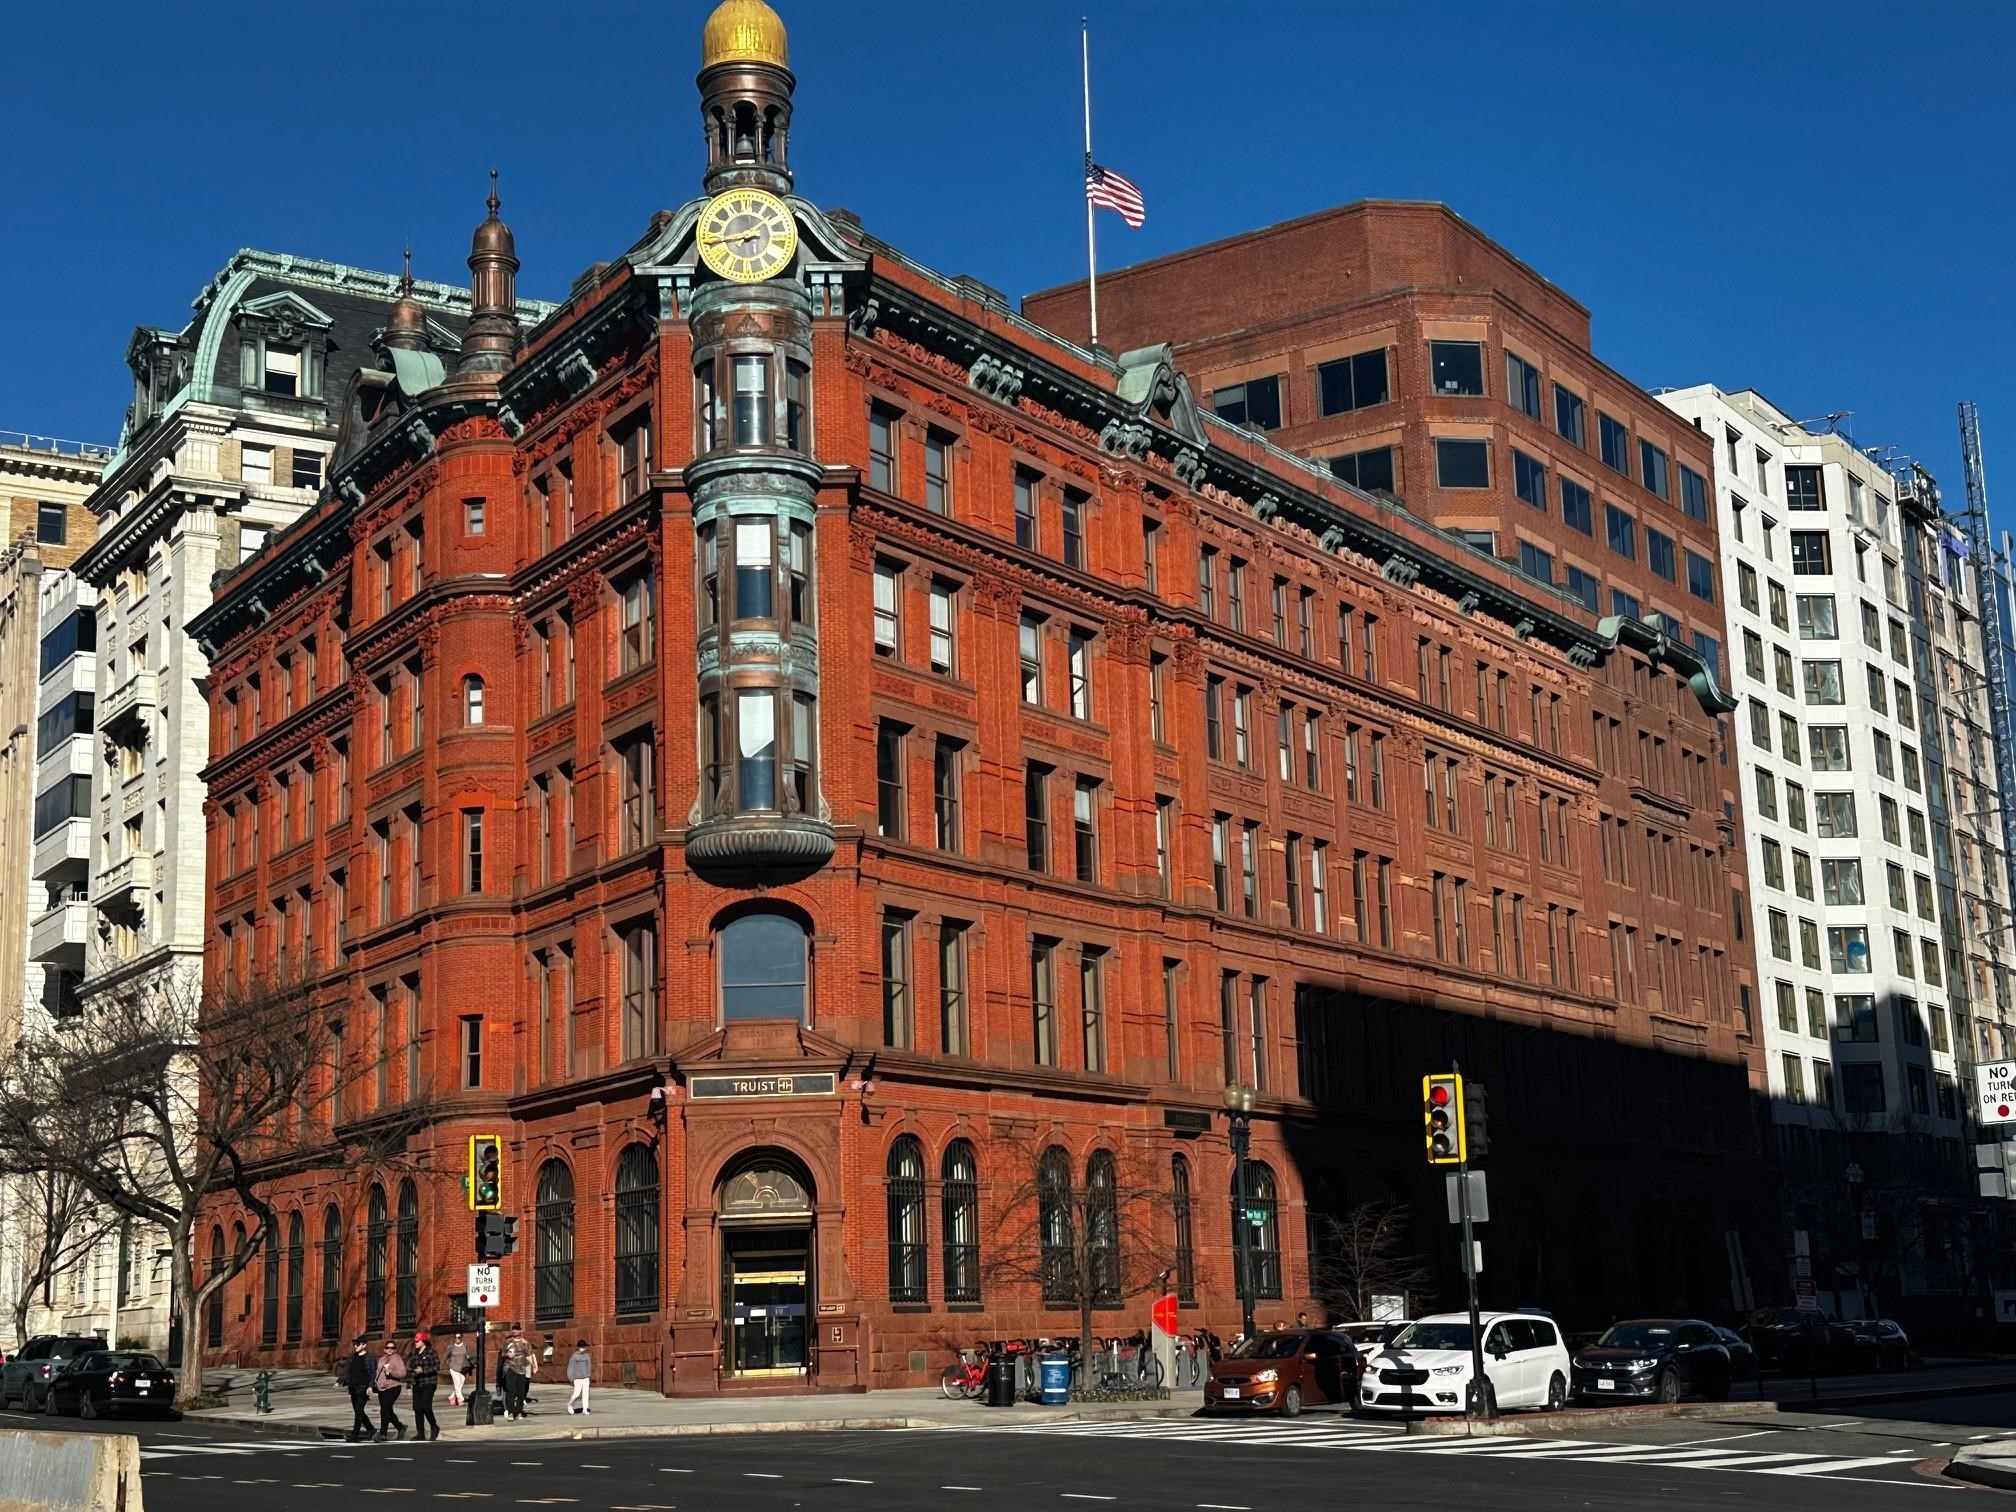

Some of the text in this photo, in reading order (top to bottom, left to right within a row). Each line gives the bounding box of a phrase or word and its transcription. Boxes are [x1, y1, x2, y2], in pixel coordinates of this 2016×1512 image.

[1989, 1066, 2009, 1079] NO
[732, 1081, 776, 1092] TRUIST
[1983, 1093, 1997, 1104] ON
[477, 1267, 491, 1275] NO
